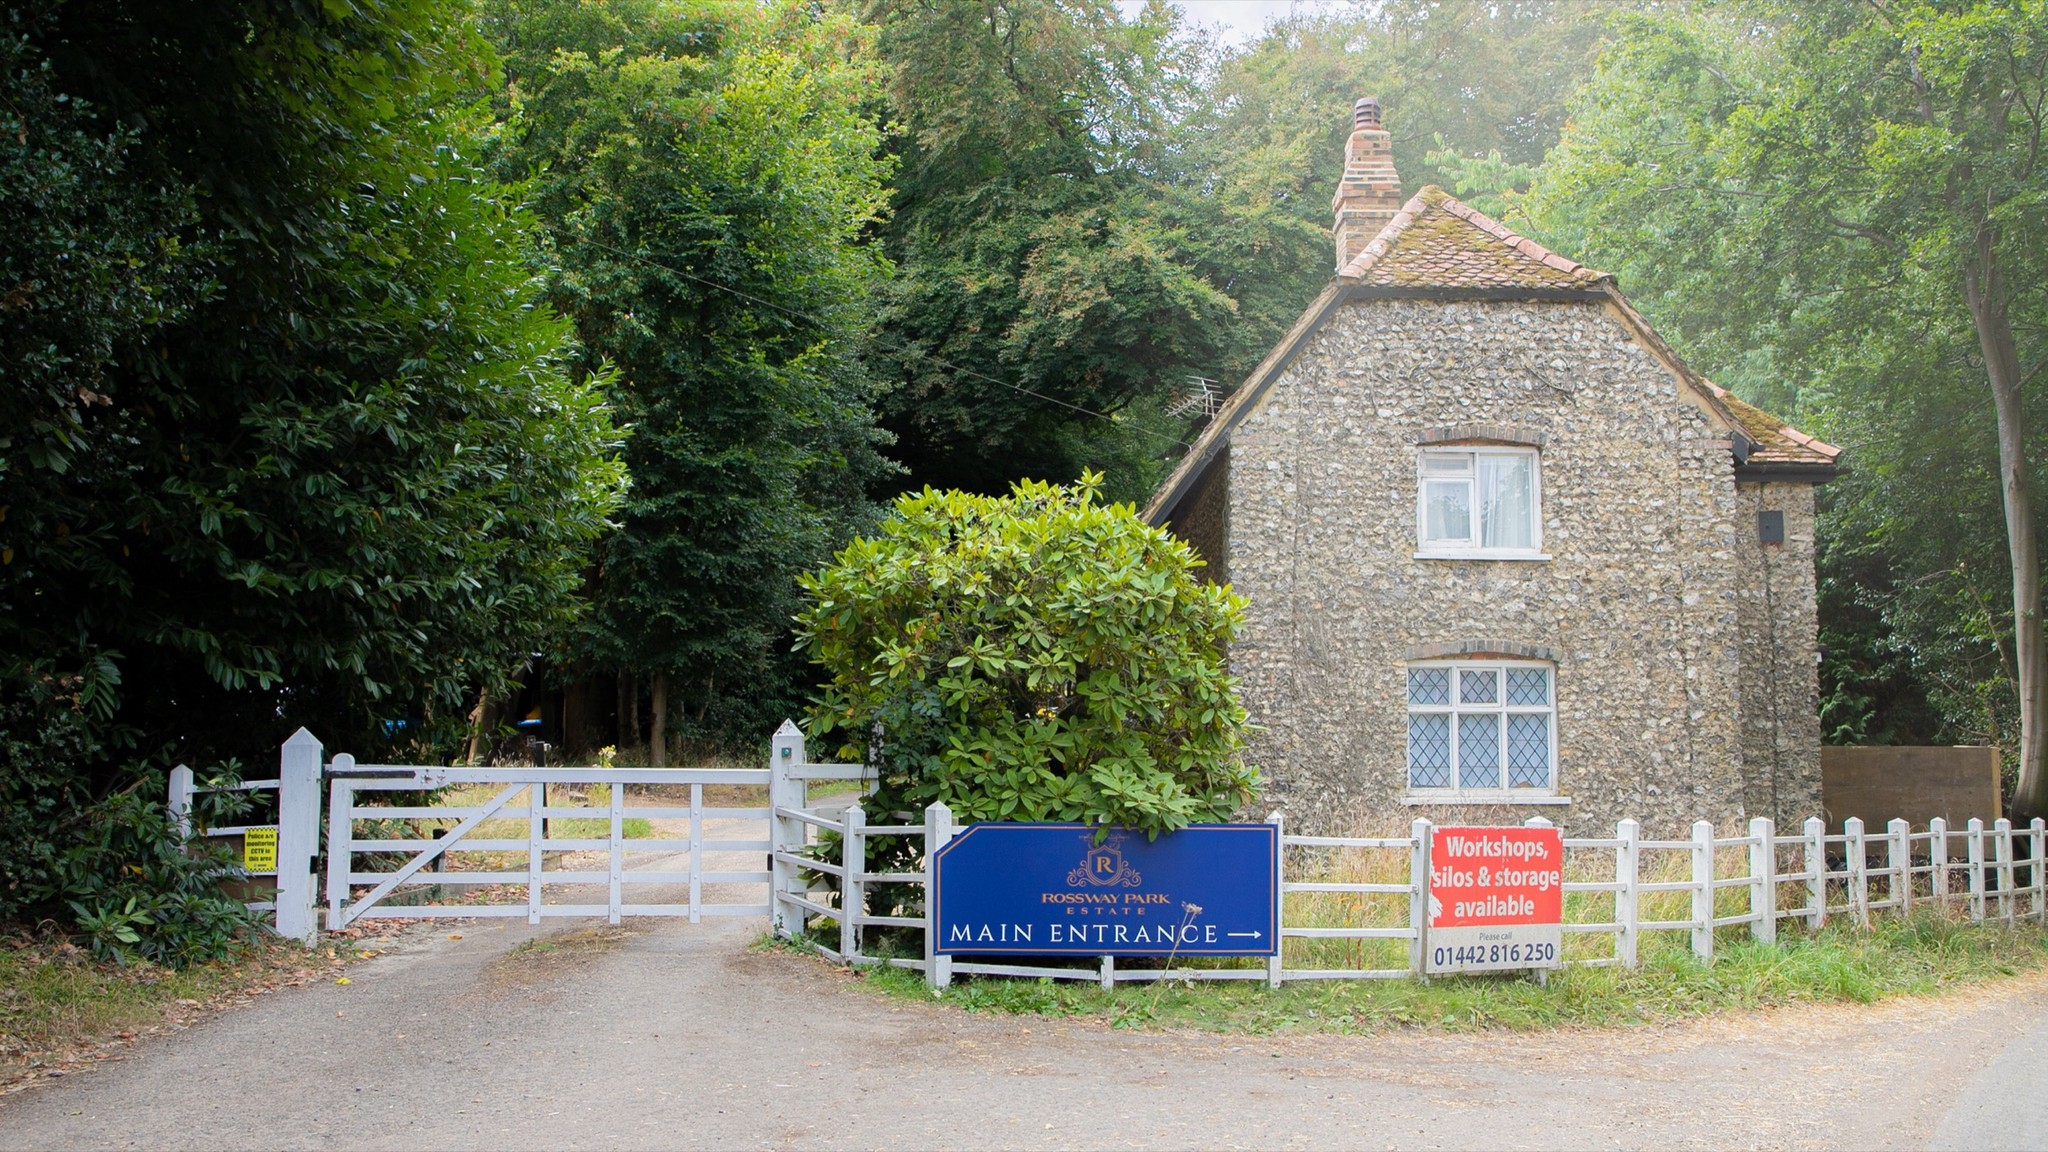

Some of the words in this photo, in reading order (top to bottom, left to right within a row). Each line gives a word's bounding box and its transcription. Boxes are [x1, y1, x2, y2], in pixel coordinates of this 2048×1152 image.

[1446, 835, 1549, 861] Workshops,
[1097, 856, 1111, 873] R
[1433, 866, 1473, 888] silos
[1477, 866, 1490, 887] &
[1495, 869, 1559, 891] storage
[1042, 893, 1121, 904] ROSSWAY
[1125, 893, 1171, 904] PARK
[1454, 895, 1534, 917] available
[1067, 907, 1146, 915] ESTATE
[950, 924, 1033, 942] MAIN
[1051, 925, 1218, 943] ENTRANCE
[1501, 932, 1512, 940] call
[1435, 946, 1485, 966] 01442
[1490, 944, 1520, 962] 816
[1524, 943, 1554, 961] 250
